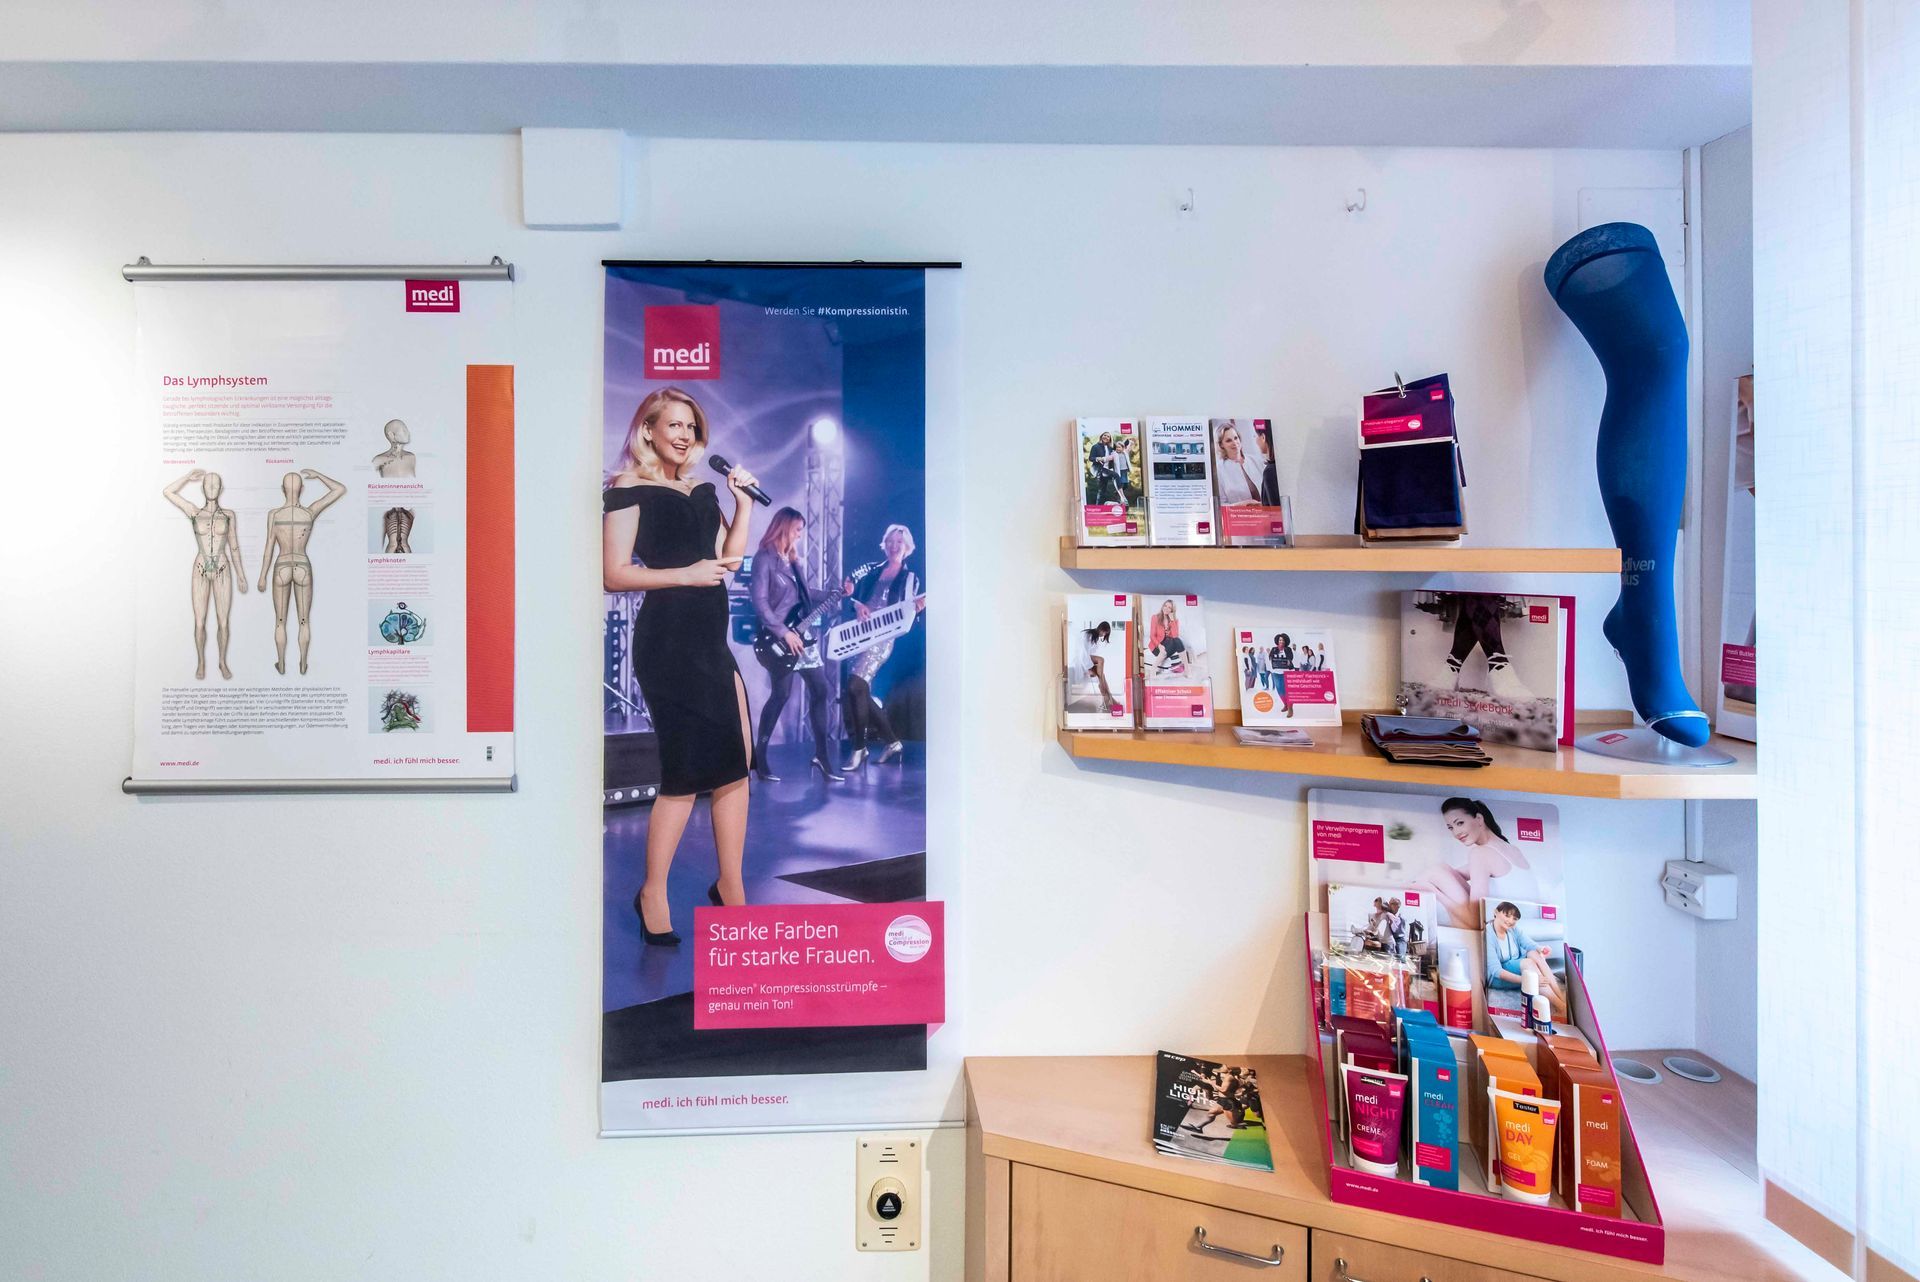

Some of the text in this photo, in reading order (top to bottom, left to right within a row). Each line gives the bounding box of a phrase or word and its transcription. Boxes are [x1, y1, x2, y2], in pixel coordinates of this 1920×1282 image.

[412, 286, 454, 301] medi
[764, 306, 910, 318] Werden Sie #Kompressionistin.
[653, 342, 710, 364] medi
[163, 375, 268, 388] Das Lymphsystem
[1520, 828, 1541, 838] medi
[709, 921, 838, 941] Starke Farben
[709, 946, 876, 967] für starke Frauen.
[760, 981, 878, 995] Kompressionsstrümpfe
[708, 1000, 794, 1014] genau mein Ton!
[1174, 1083, 1206, 1098] HIGH
[1424, 1091, 1444, 1101] medi
[642, 1093, 789, 1109] medi. ich fühl mich besser.
[1355, 1094, 1378, 1104] medi
[1355, 1103, 1398, 1121] NIGHT
[1514, 1102, 1538, 1112] Tester
[1356, 1124, 1381, 1136] CREME
[1506, 1120, 1532, 1132] medi
[1586, 1120, 1608, 1130] medi
[1506, 1130, 1534, 1146] DAY
[1586, 1159, 1608, 1169] FOAM
